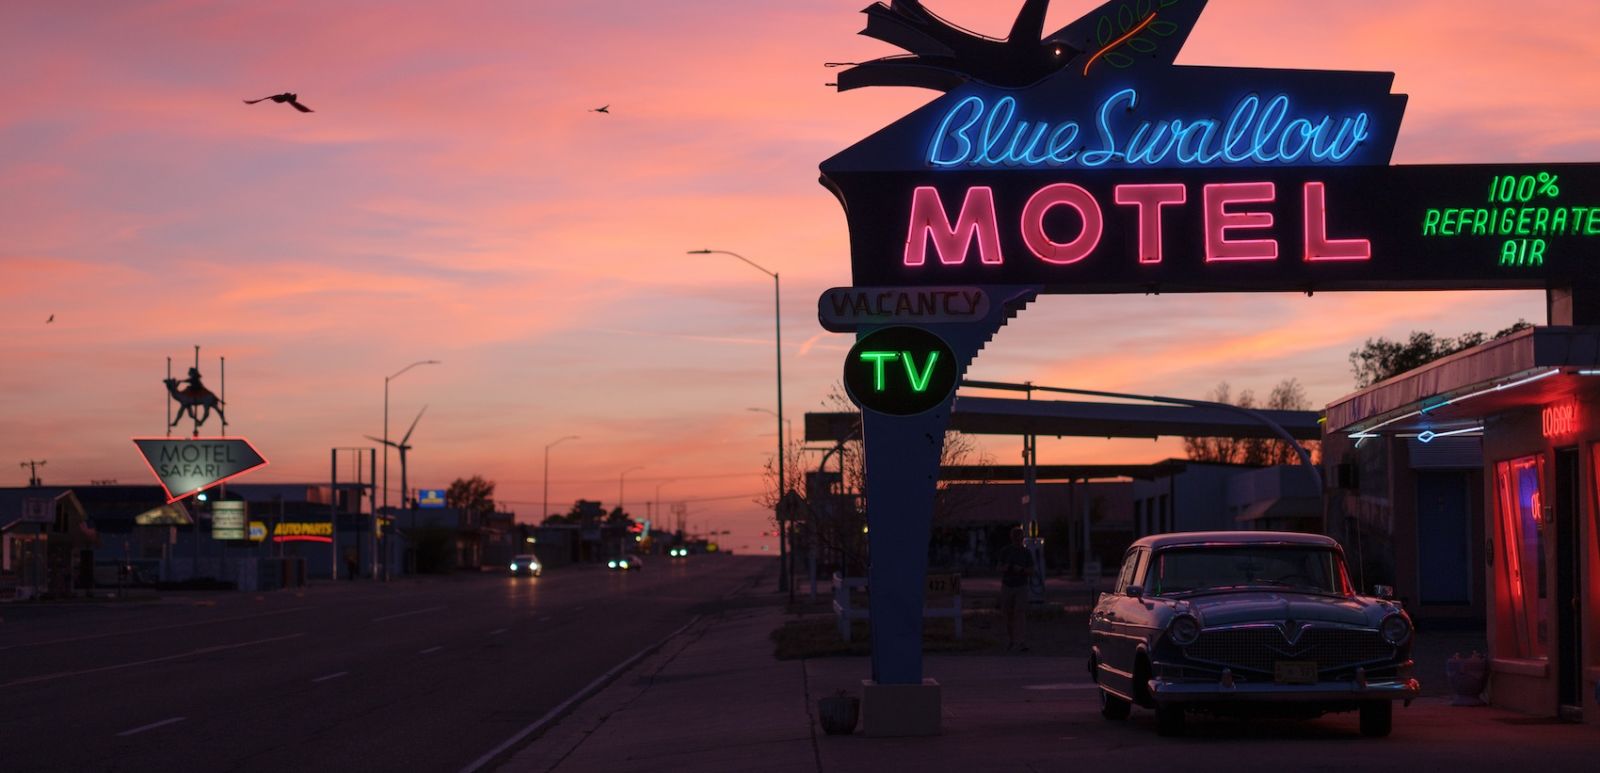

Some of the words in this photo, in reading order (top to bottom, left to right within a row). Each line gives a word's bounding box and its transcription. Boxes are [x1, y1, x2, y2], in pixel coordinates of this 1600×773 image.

[929, 94, 1079, 167] Blue
[1081, 88, 1368, 166] Swallow
[1488, 171, 1560, 203] 100%
[903, 181, 1371, 266] MOTEL
[1498, 239, 1546, 266] AIR
[830, 290, 983, 317] VACANCY
[859, 350, 940, 392] TV
[1542, 406, 1576, 437] LOBBY
[160, 444, 237, 463] MOTEL
[160, 463, 221, 478] SAFARI
